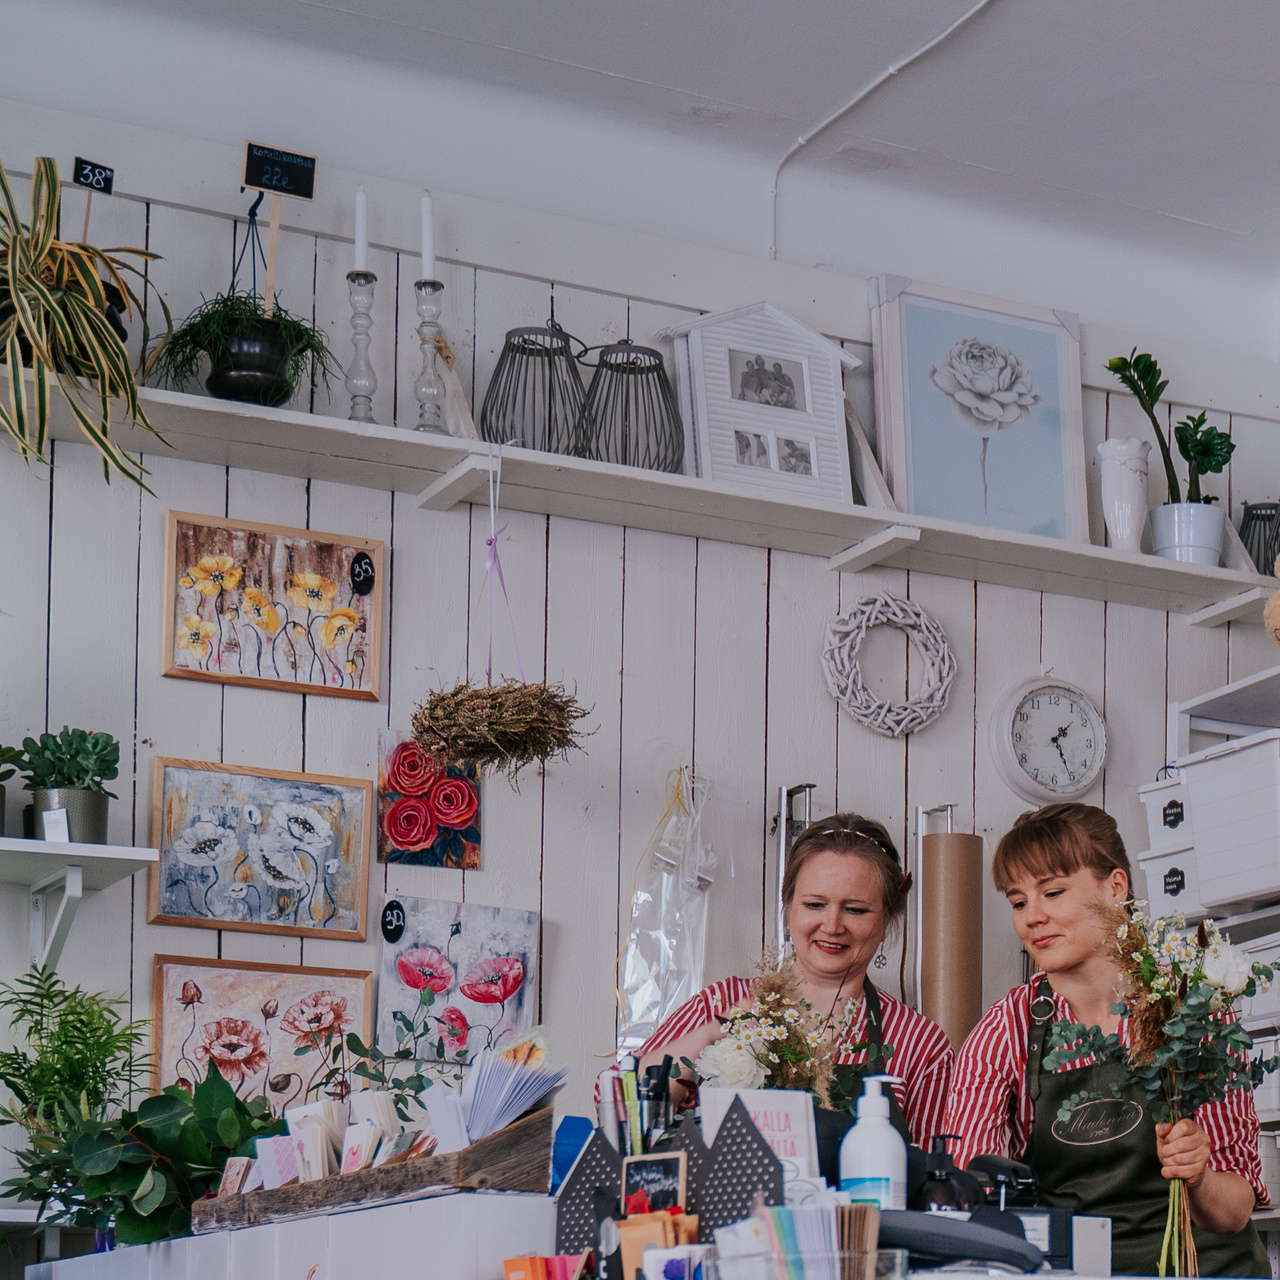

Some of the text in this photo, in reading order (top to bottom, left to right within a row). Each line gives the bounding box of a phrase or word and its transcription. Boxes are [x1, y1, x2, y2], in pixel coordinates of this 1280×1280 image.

[1031, 699, 1040, 710] 11
[1048, 695, 1060, 706] 12
[1069, 703, 1074, 713] 1
[1019, 711, 1029, 722] 10
[1081, 718, 1087, 727] 2
[1015, 732, 1021, 743] 9
[1086, 739, 1092, 749] 3
[1020, 753, 1027, 764] 8
[1081, 759, 1088, 769] 4
[1033, 768, 1039, 780] 7
[1069, 772, 1075, 781] 5
[1051, 775, 1058, 785] 6
